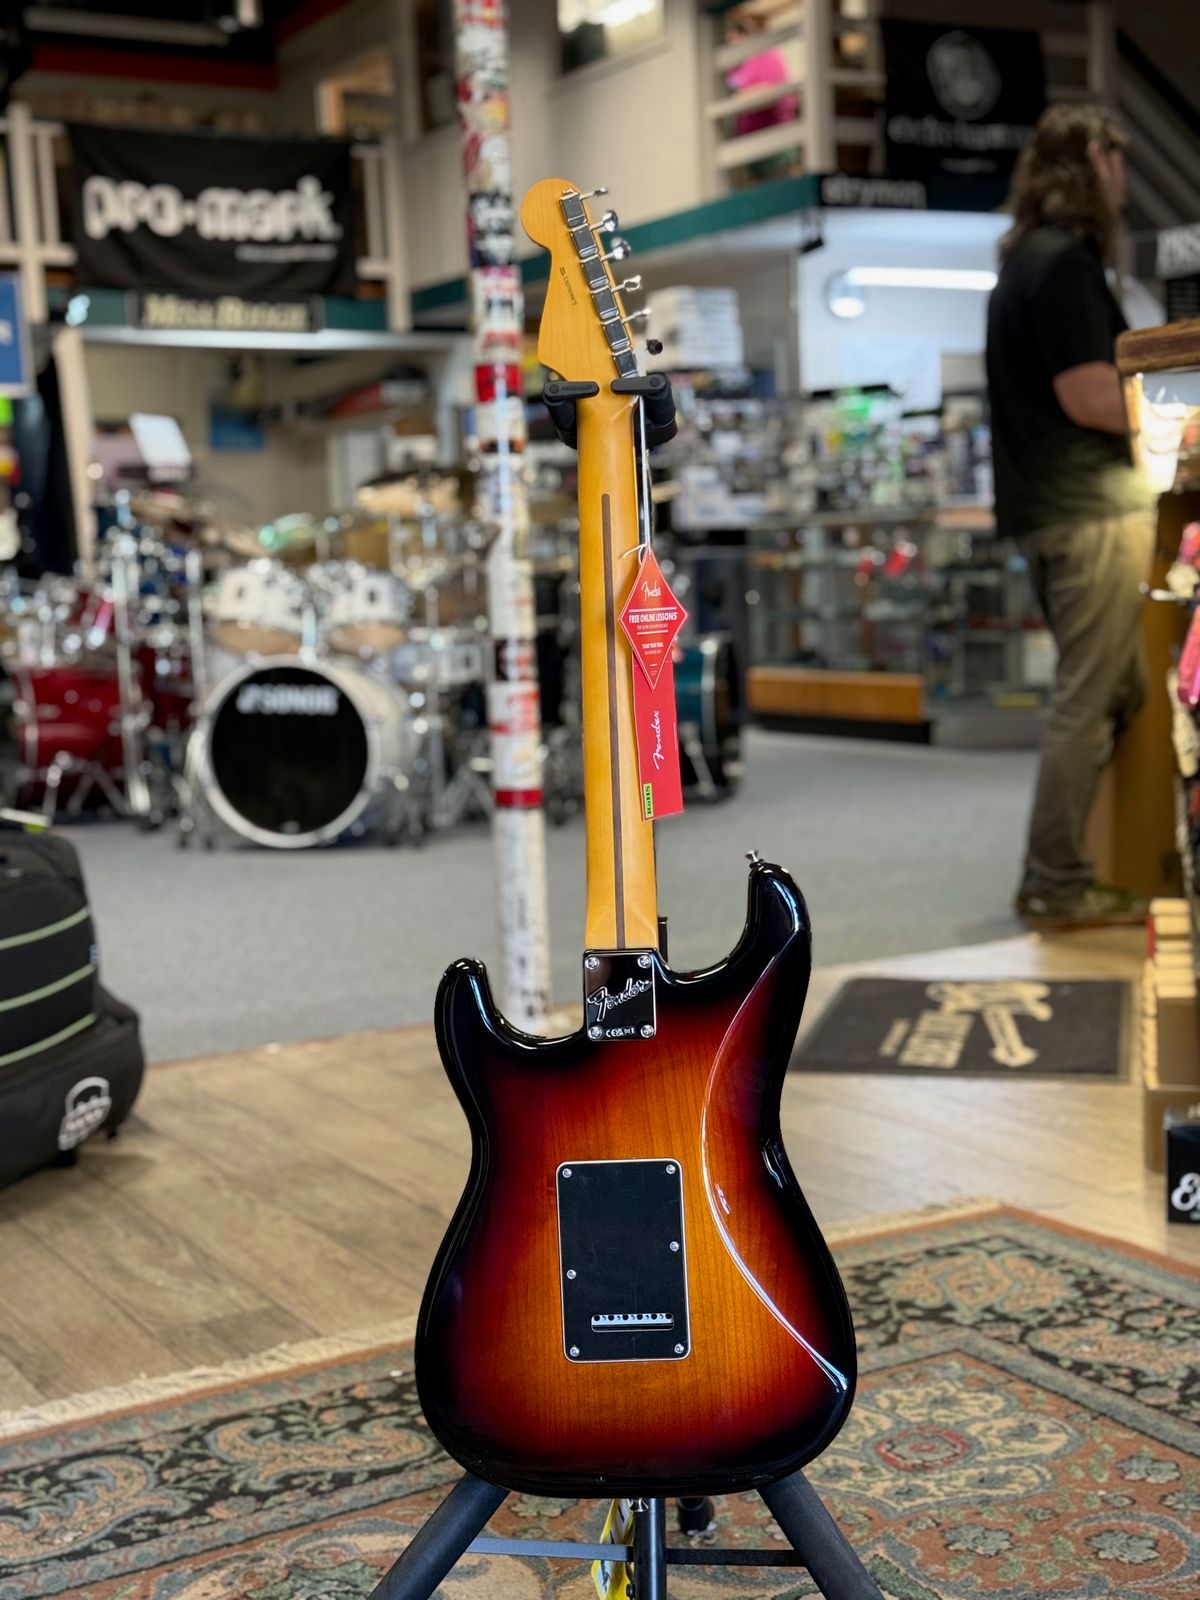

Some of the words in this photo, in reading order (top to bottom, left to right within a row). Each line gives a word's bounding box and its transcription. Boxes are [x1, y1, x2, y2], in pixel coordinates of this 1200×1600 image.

[641, 580, 661, 601] Fender
[629, 614, 640, 623] FREE
[640, 613, 656, 622] ONLINE
[656, 612, 678, 622] LESSONS
[651, 708, 664, 770] Fender
[587, 978, 653, 1022] Fender
